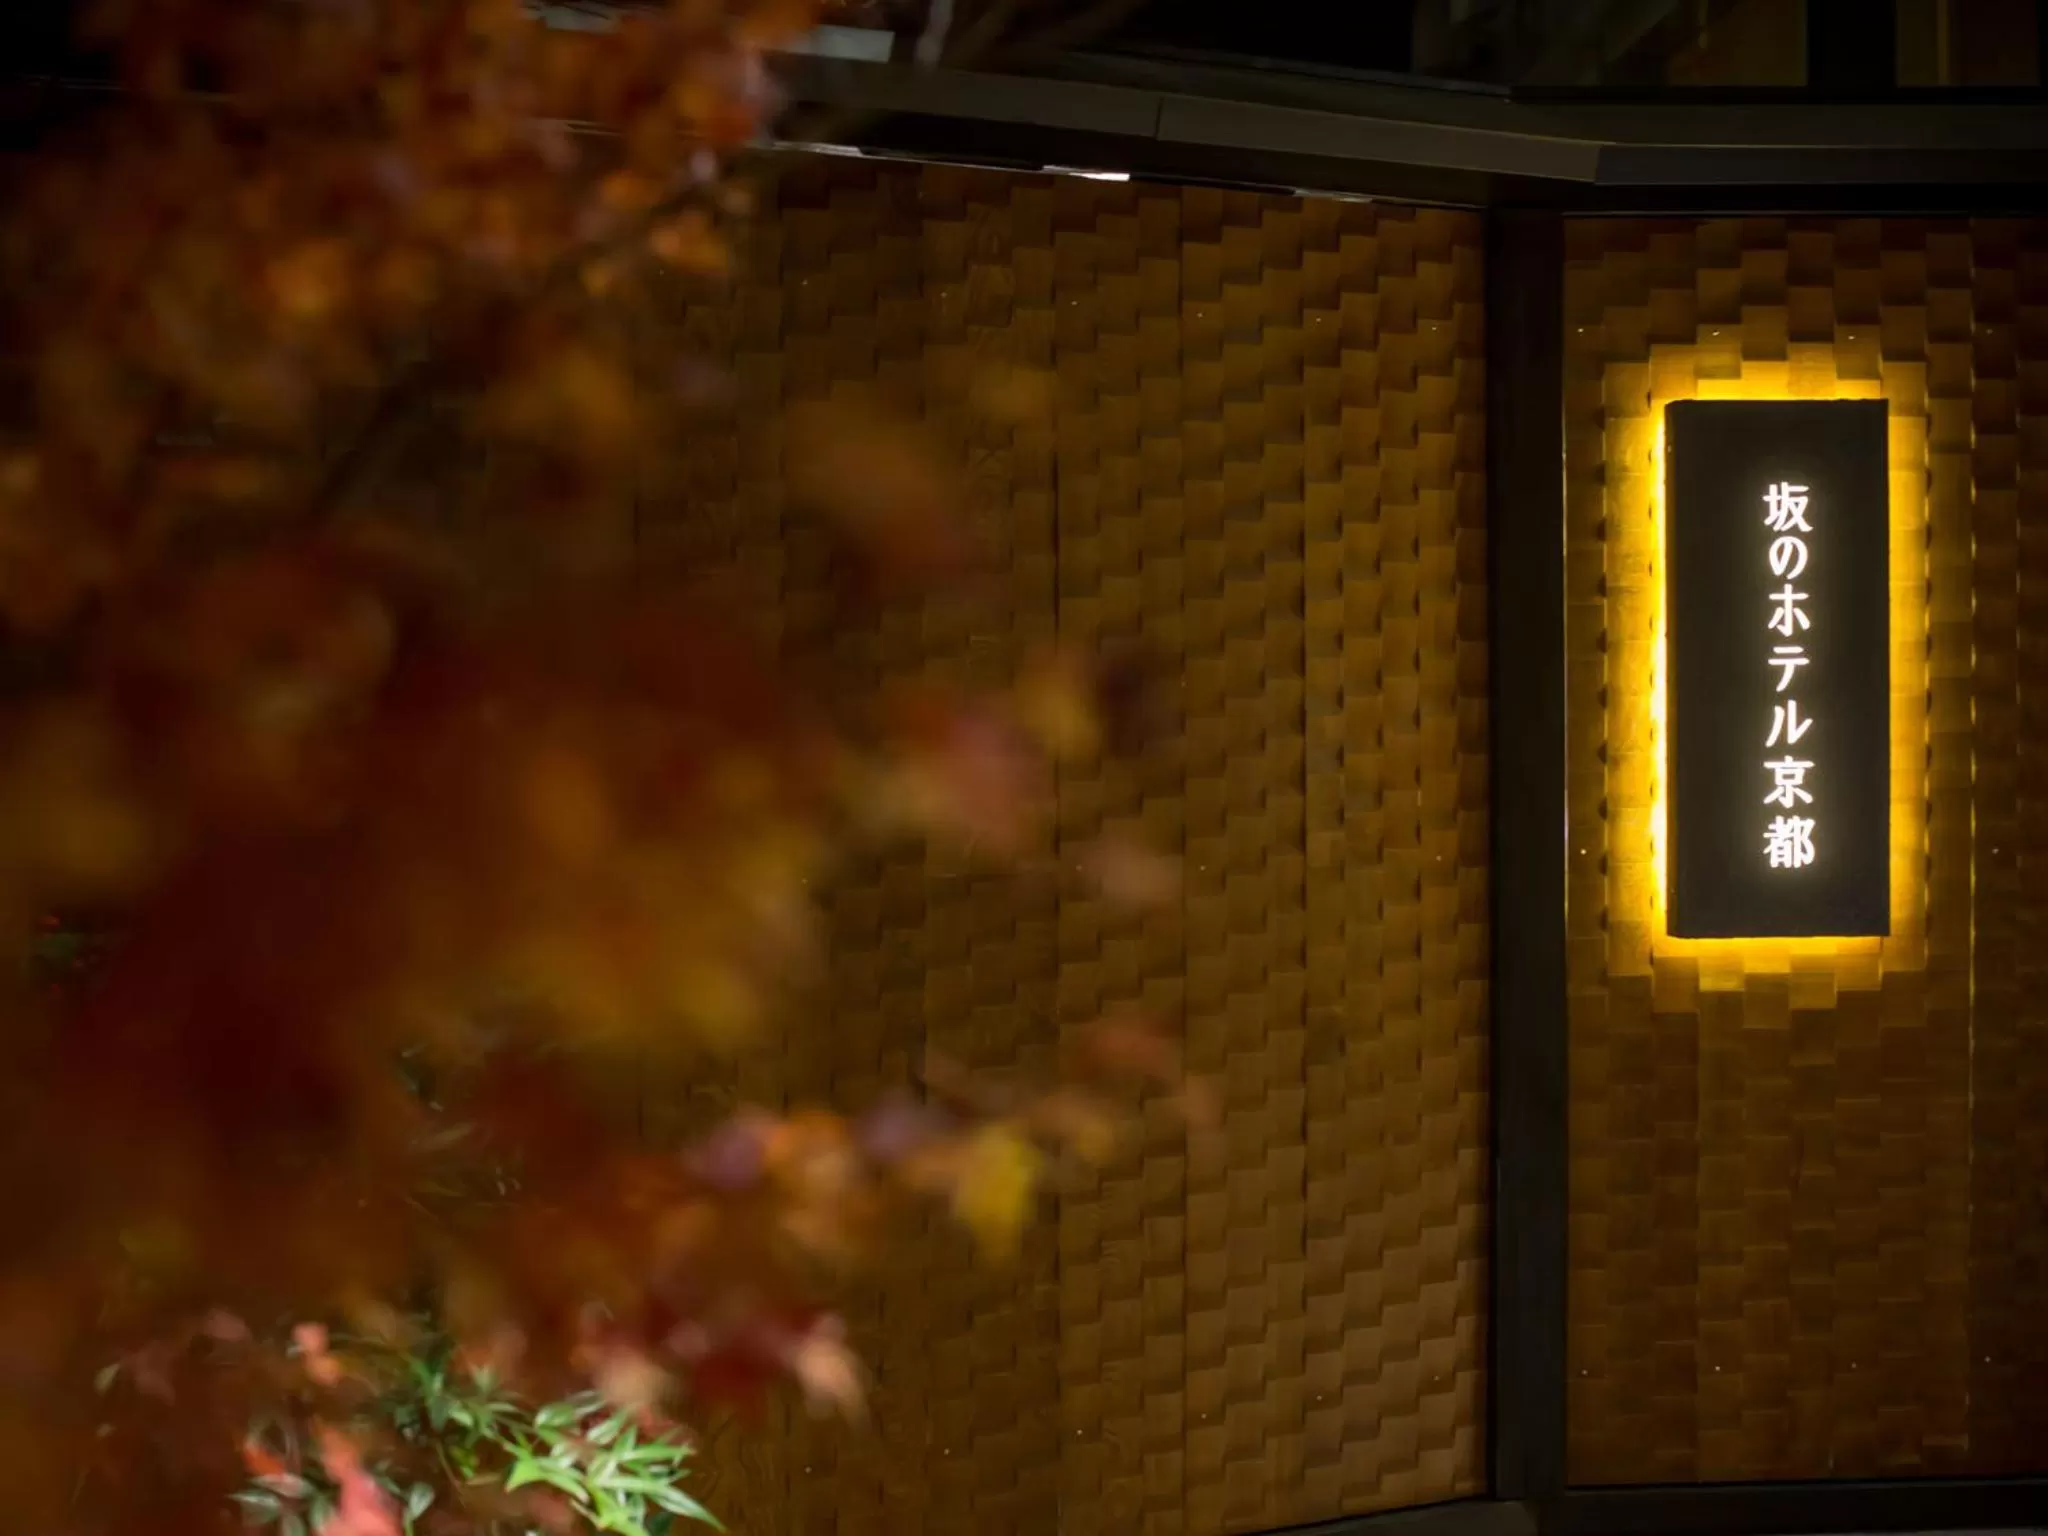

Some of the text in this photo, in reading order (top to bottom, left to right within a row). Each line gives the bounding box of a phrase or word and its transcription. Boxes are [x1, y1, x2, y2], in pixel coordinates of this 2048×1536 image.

[1762, 481, 1817, 869] 坂のホテル京都
